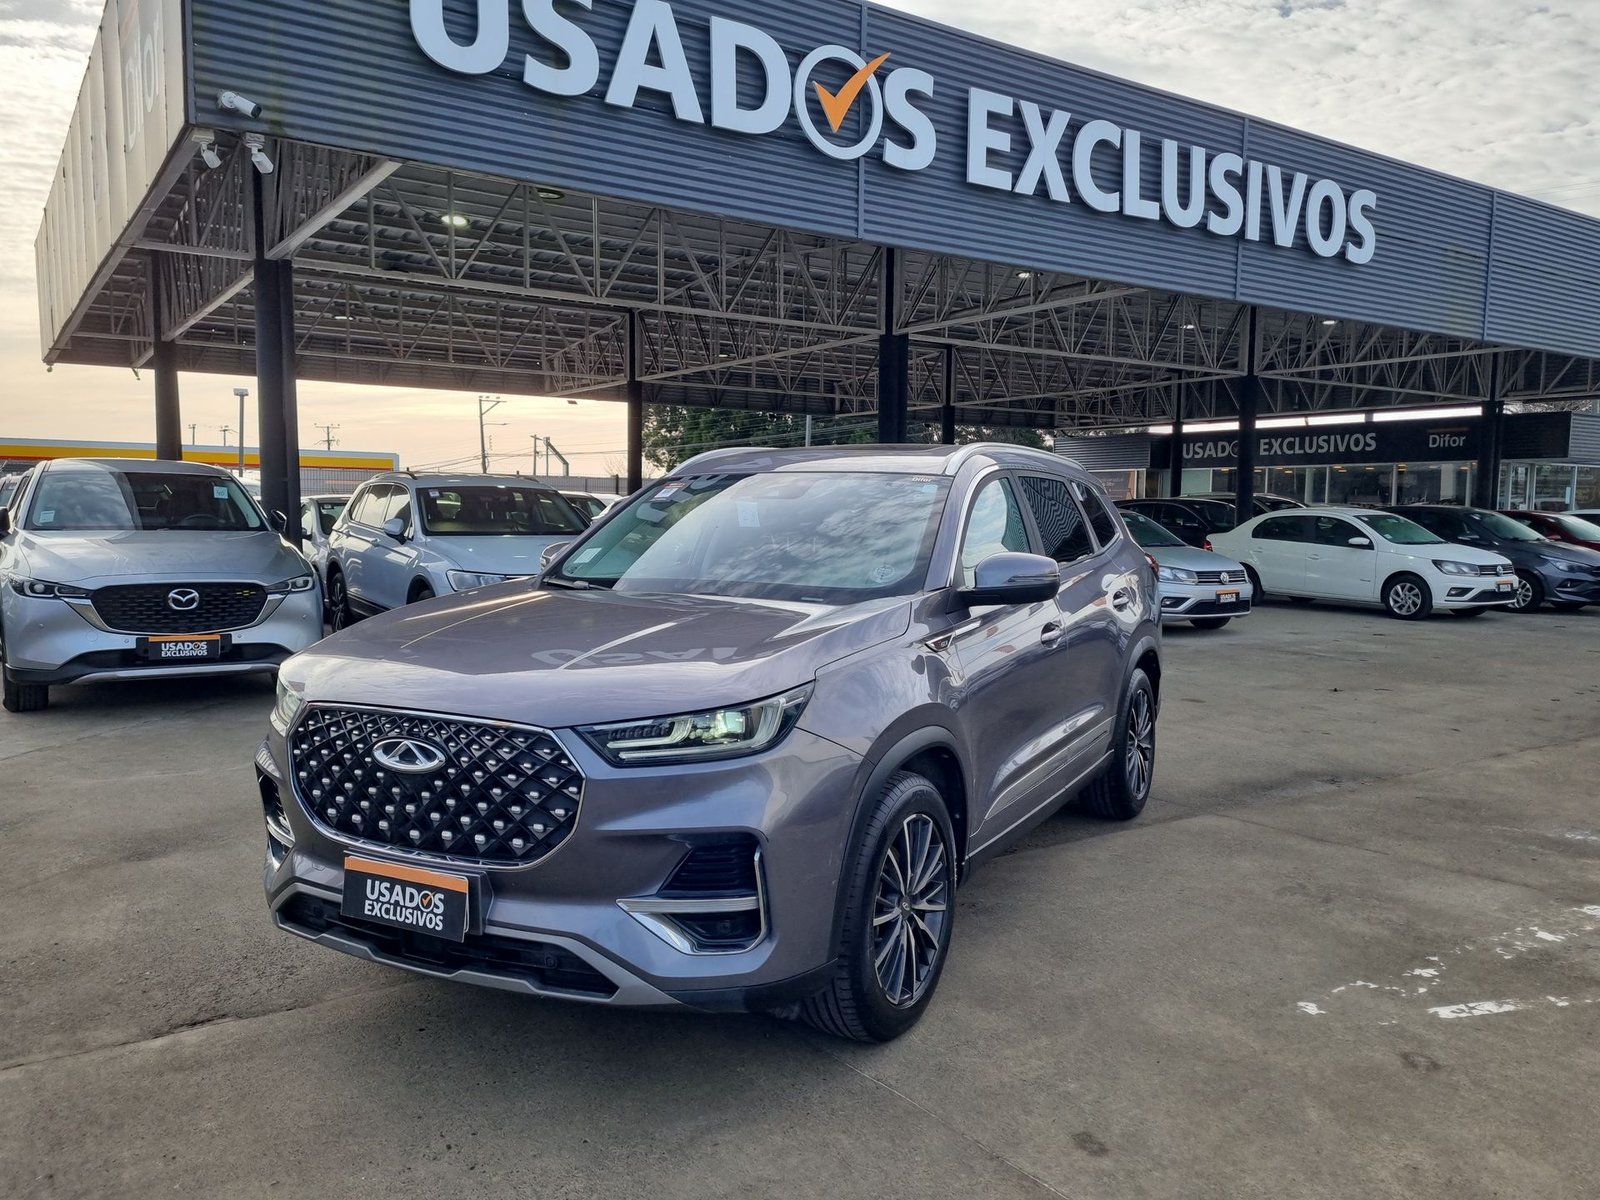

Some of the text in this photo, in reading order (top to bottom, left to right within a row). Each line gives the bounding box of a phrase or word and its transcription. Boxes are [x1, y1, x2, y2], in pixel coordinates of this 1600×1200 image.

[409, 0, 1378, 265] USADOS EXCLUSIVOS
[1182, 432, 1466, 459] USADO EXCLUSIVOS Difor
[161, 641, 208, 651] USADOS
[161, 649, 208, 657] EXCLUSIVOS
[366, 878, 445, 914] USADOS
[364, 899, 444, 931] EXCLUSIVOS
